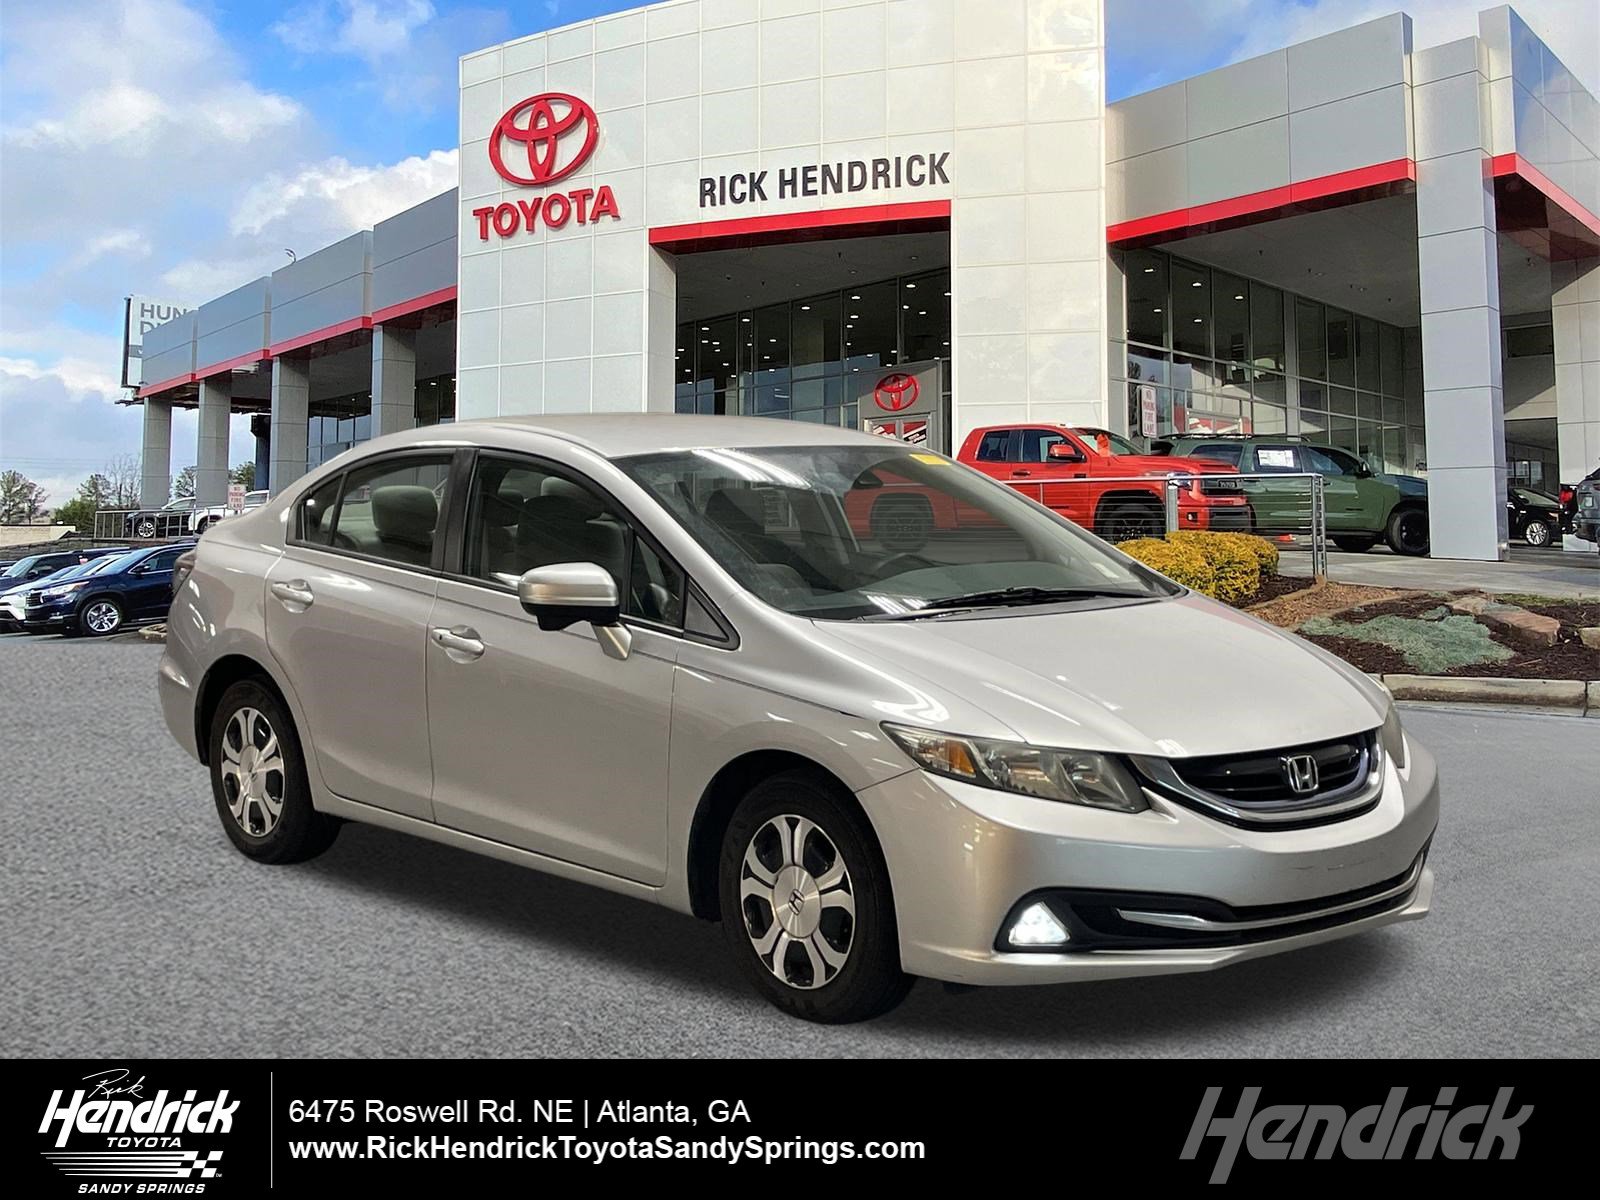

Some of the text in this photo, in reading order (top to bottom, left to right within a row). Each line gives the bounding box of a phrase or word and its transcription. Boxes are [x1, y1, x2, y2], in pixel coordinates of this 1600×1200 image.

[699, 152, 951, 208] RICK HENDRICK
[473, 184, 621, 240] TOYOTA
